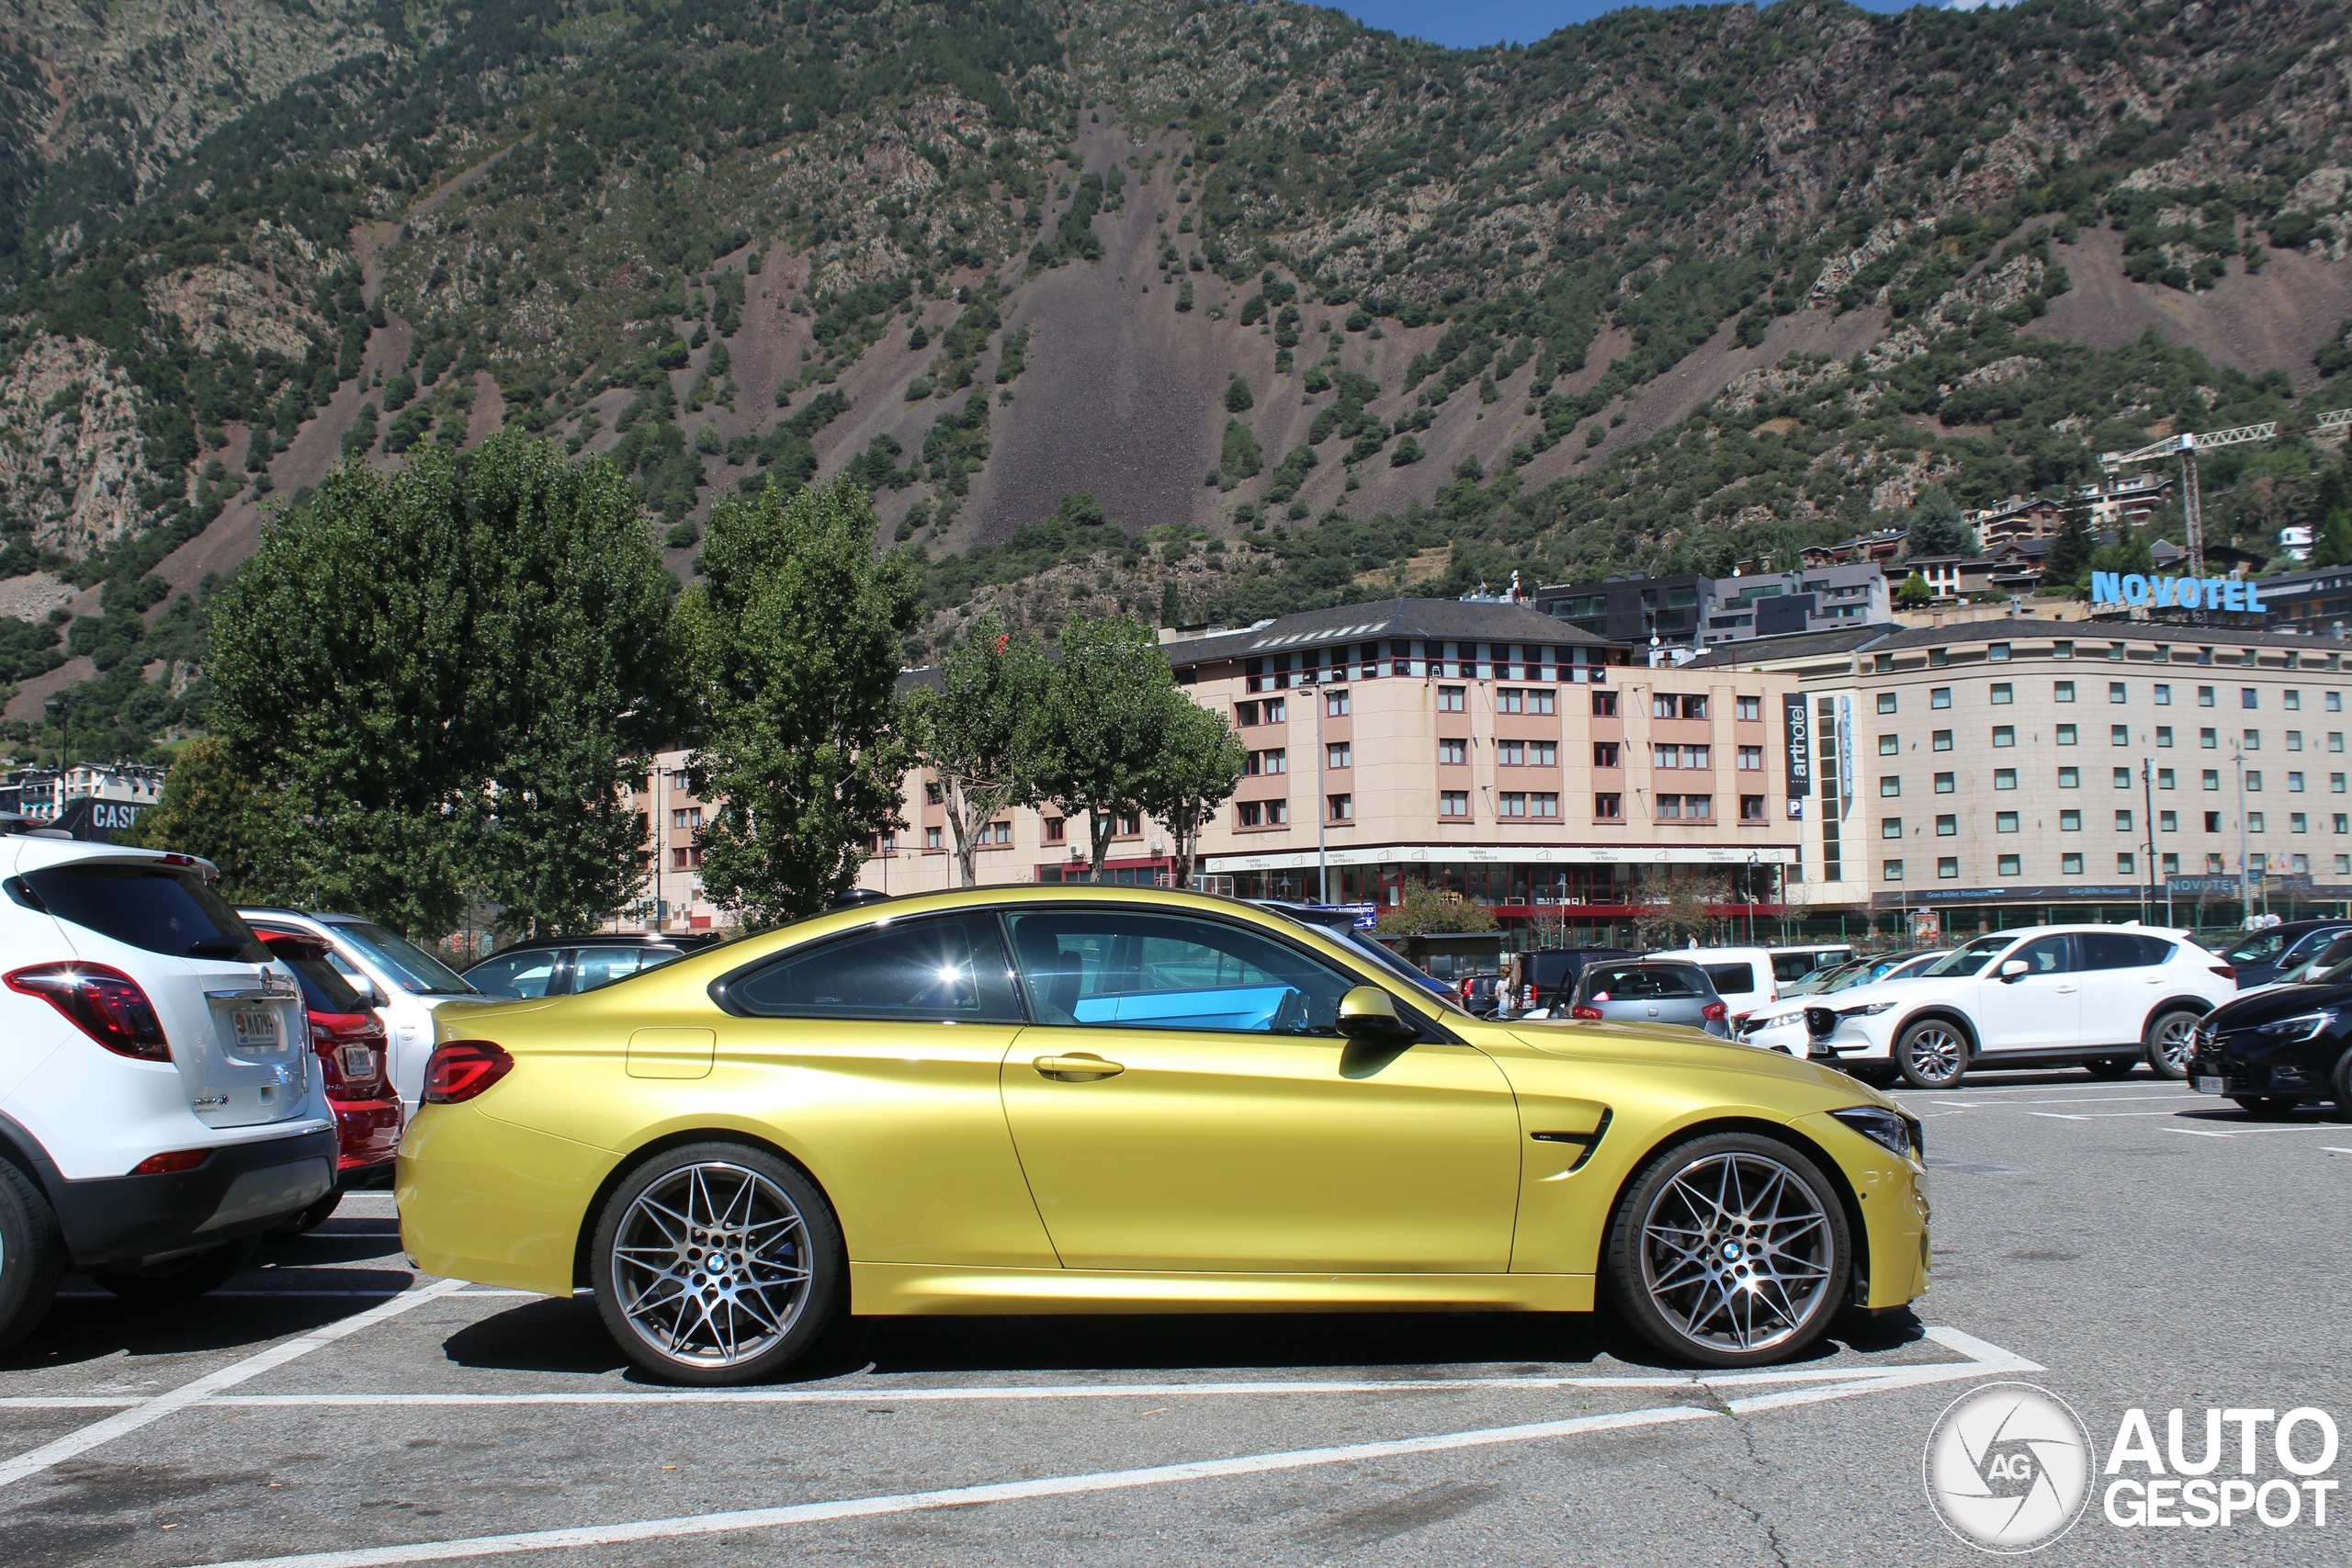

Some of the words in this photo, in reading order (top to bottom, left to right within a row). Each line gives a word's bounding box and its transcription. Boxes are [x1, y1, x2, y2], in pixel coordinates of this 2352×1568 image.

[2091, 571, 2267, 613] NOVOTEL
[1788, 705, 1807, 777] arthotel
[2169, 878, 2234, 891] NOVOTEL
